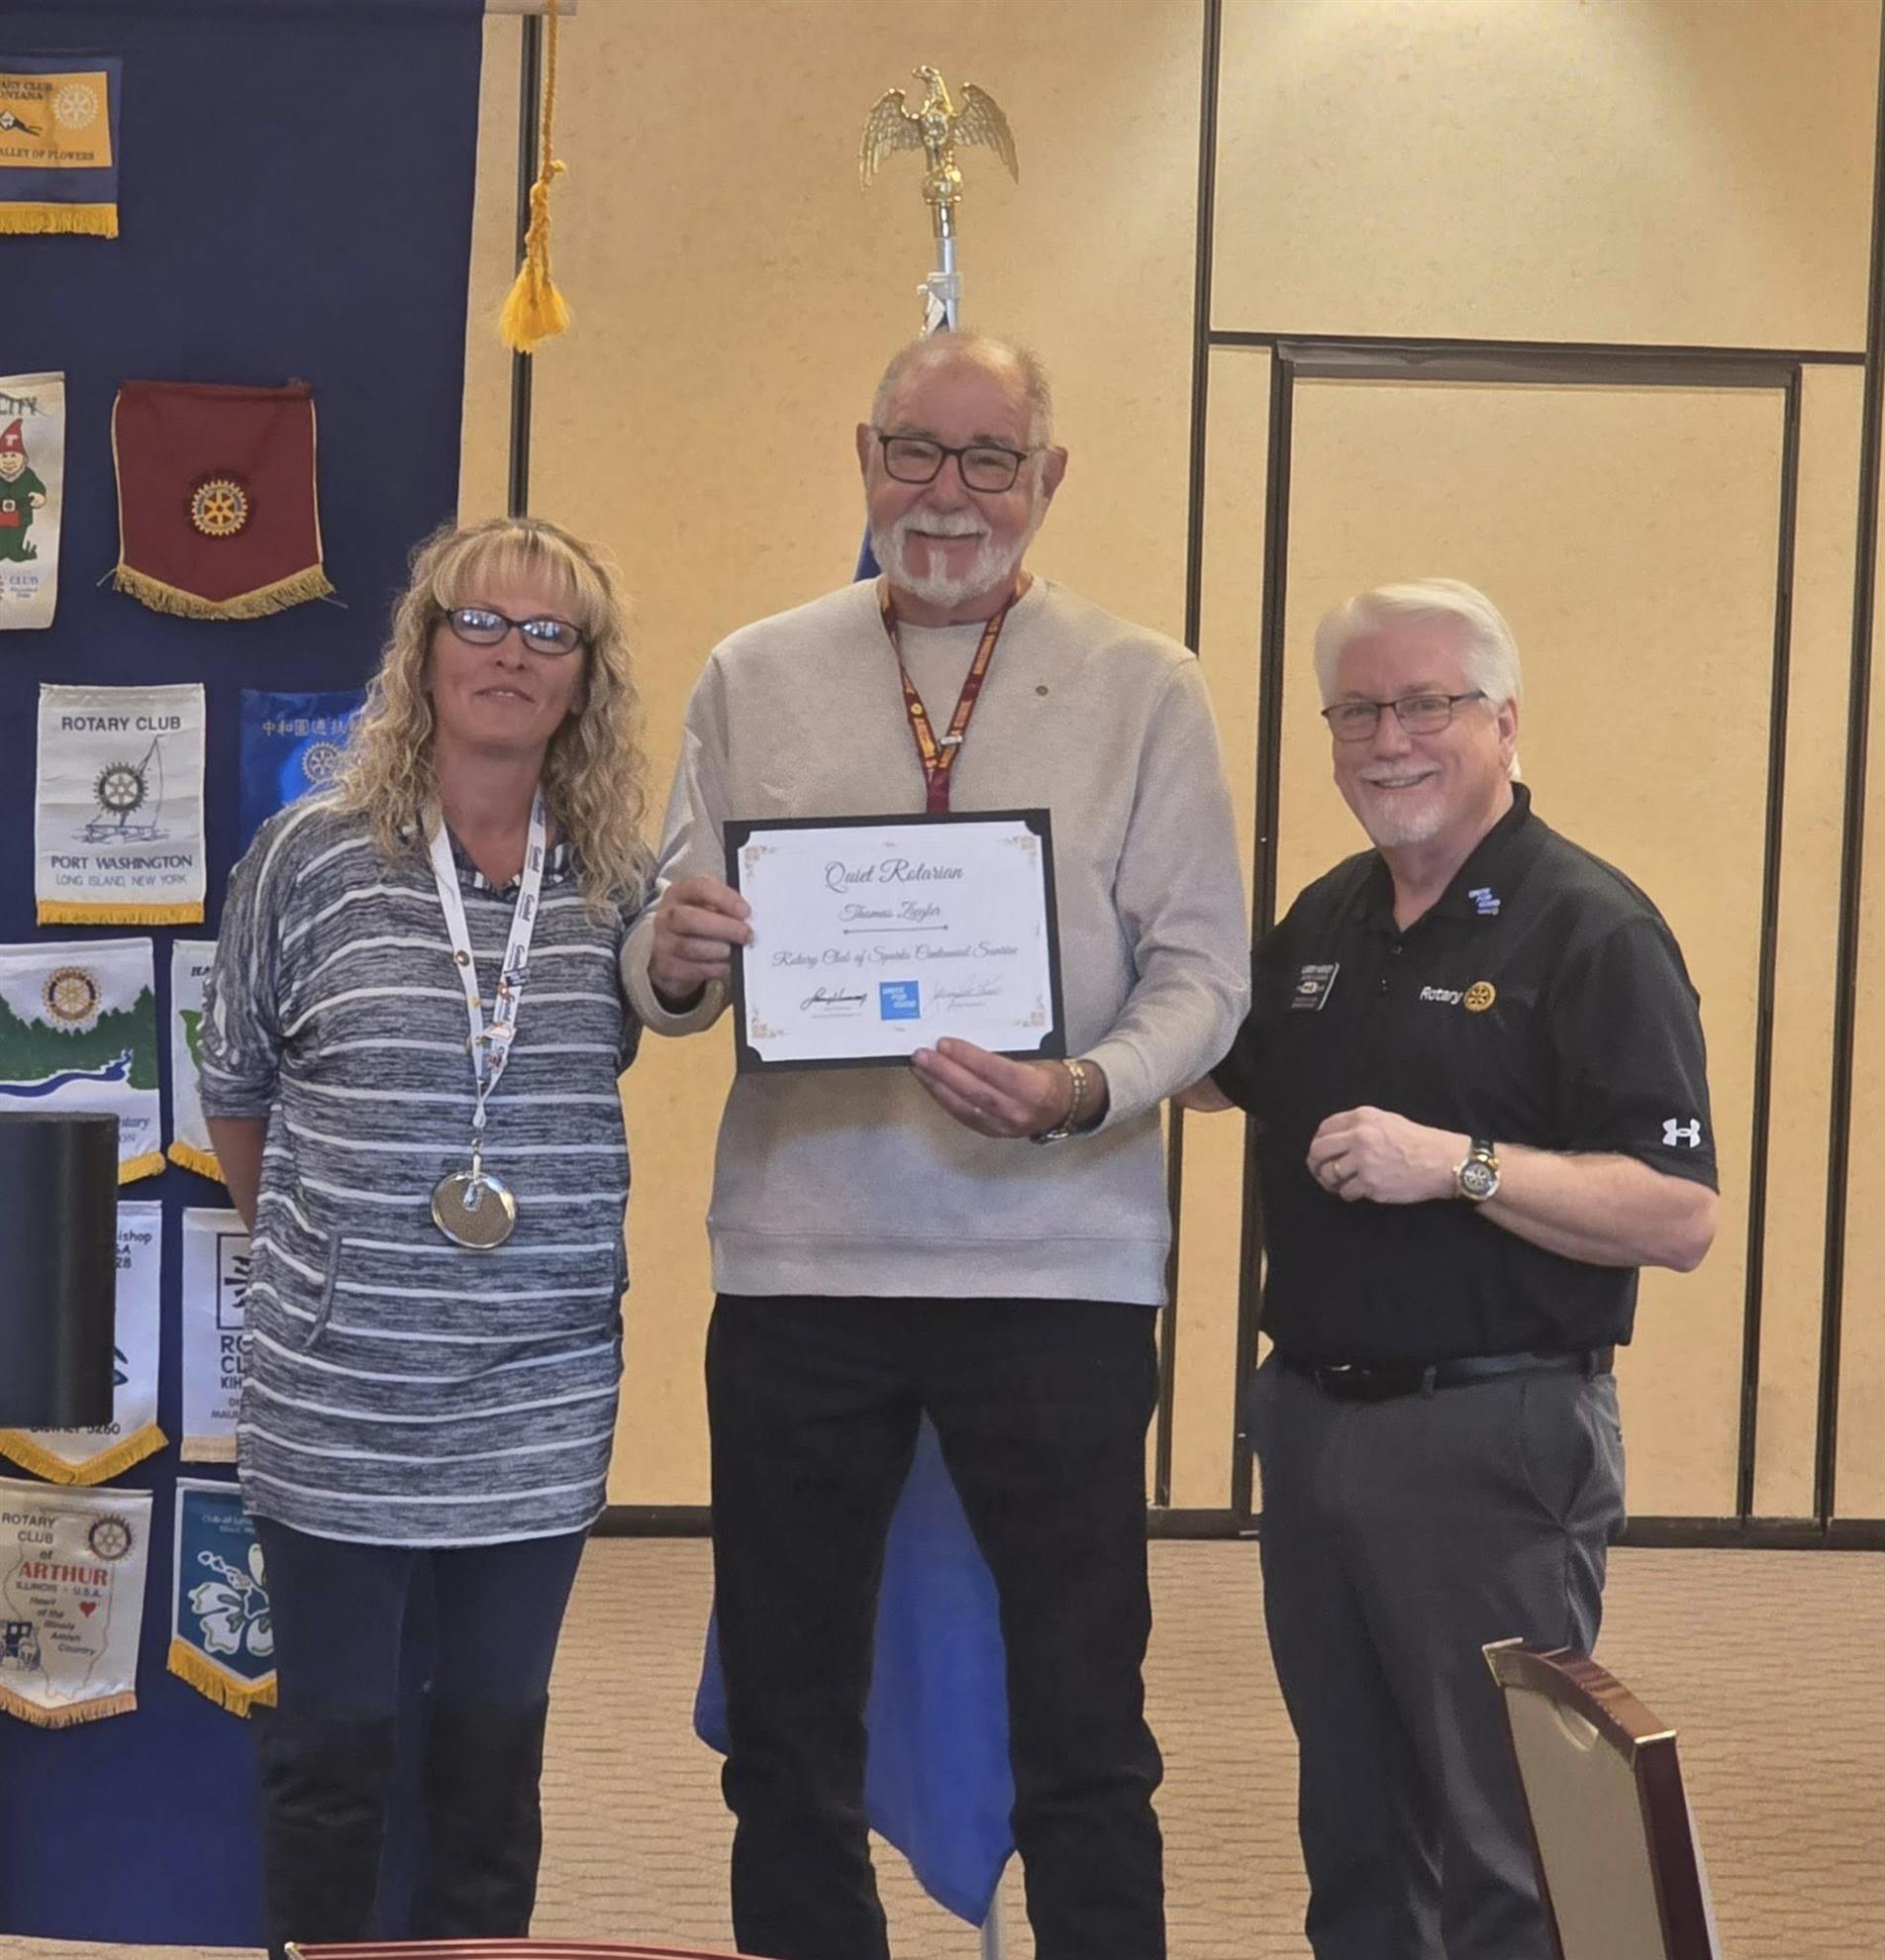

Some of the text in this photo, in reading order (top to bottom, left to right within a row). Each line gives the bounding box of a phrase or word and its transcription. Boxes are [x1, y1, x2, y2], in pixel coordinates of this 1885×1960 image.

[24, 82, 52, 92] CLUB
[49, 150, 94, 160] FLOWERS
[61, 716, 181, 732] ROTARY CLUB
[50, 854, 193, 870] PORT WASHINGTON
[55, 873, 83, 887] LONG
[131, 875, 156, 886] NEW
[159, 873, 187, 886] YORK
[825, 857, 963, 894] Quiet Rotarian
[1420, 986, 1463, 1005] Rotary
[118, 1229, 152, 1245] ishop
[2, 1513, 55, 1528] ROTARY
[17, 1530, 53, 1544] CLUB
[40, 1549, 53, 1560] of
[19, 1561, 108, 1587] ARTHUR
[16, 1581, 57, 1593] ILLINOIS
